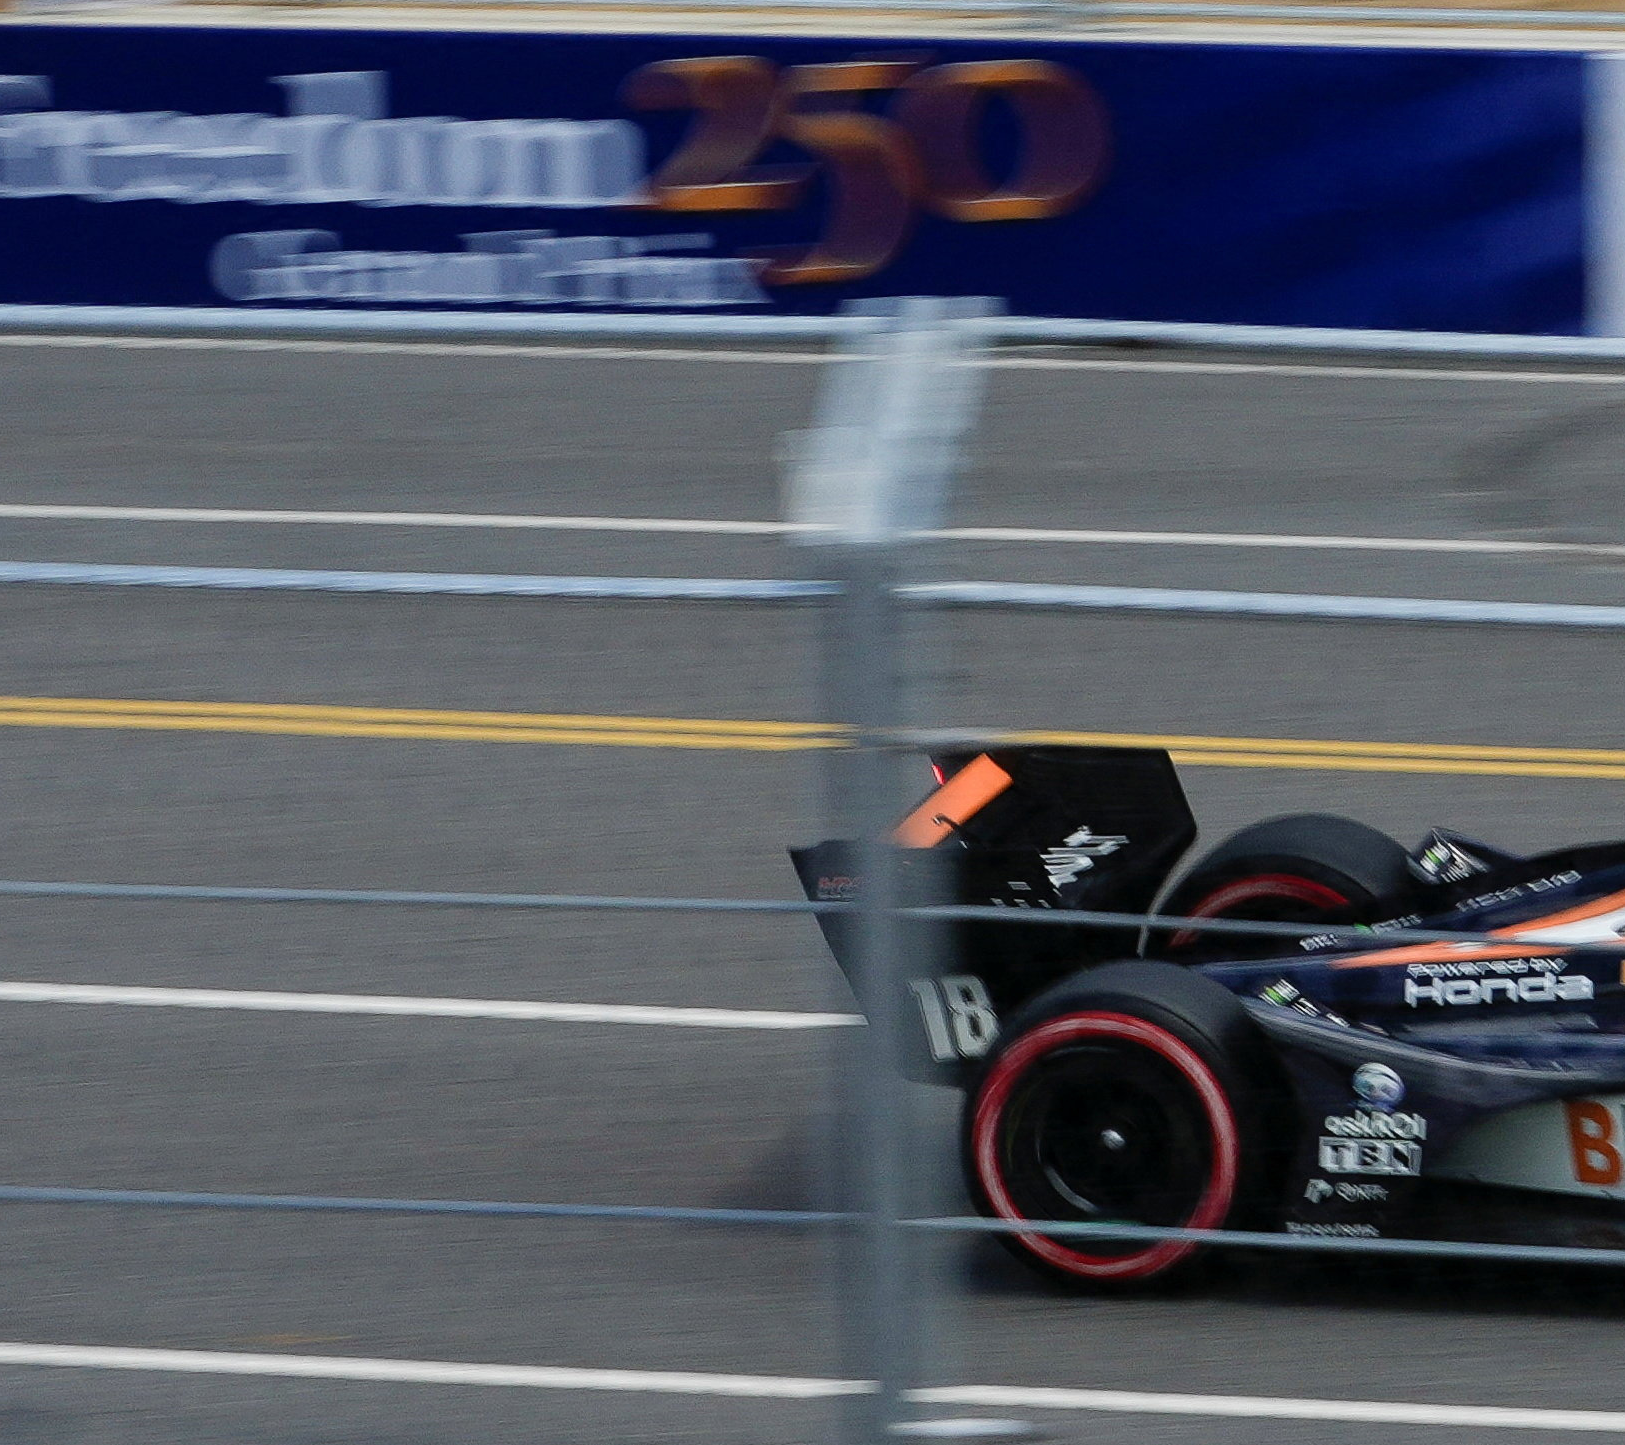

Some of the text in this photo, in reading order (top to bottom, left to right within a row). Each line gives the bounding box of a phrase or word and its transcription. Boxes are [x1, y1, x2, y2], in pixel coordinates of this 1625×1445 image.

[622, 54, 1112, 285] 250
[908, 975, 1001, 1063] 18
[1404, 971, 1595, 1008] Honda
